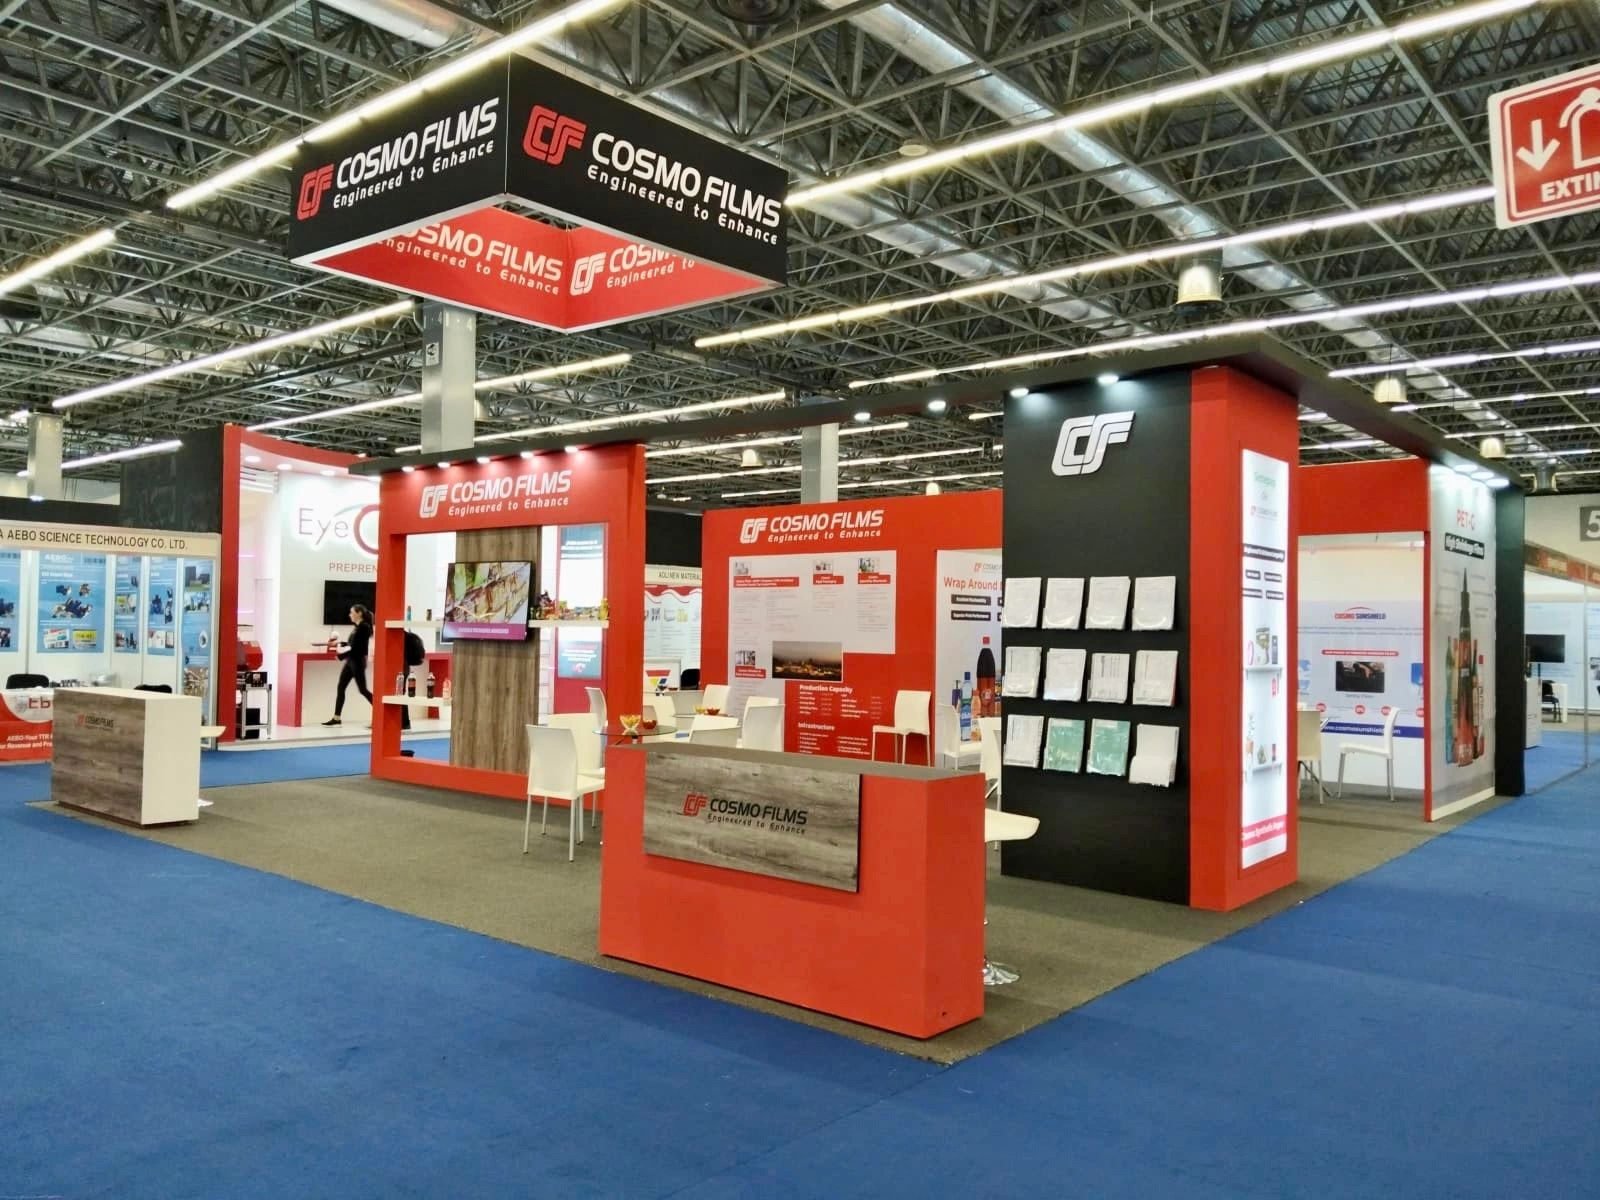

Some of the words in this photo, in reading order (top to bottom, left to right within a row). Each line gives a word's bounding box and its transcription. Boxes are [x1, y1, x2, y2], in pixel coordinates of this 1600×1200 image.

[337, 132, 418, 189] COSMO
[420, 97, 499, 159] FILMS
[333, 171, 403, 209] Engineered
[410, 166, 424, 183] to
[432, 140, 494, 173] Enhance
[592, 132, 702, 197] COSMO
[704, 175, 782, 228] FILMS
[587, 165, 684, 212] Engineered
[694, 203, 709, 221] to
[718, 213, 778, 245] Enhance
[378, 238, 467, 269] ngineered
[476, 261, 491, 275] to
[500, 270, 559, 295] Enhance
[486, 239, 563, 282] FILMS
[607, 261, 674, 288] Engineered
[451, 476, 513, 503] COSMO
[514, 470, 572, 497] FILMS
[448, 501, 502, 517] Engineered
[507, 502, 518, 511] to
[524, 497, 569, 509] Enhance
[770, 513, 829, 533] COSMO
[830, 509, 884, 529] FILMS
[7, 529, 36, 541] AEBO
[40, 531, 82, 543] SCIENCE
[85, 534, 149, 547] TECHNOLOGY
[151, 538, 167, 549] CO.
[170, 539, 188, 549] LTD.
[768, 532, 819, 543] Engineered
[824, 532, 834, 540] to
[839, 530, 881, 539] Enhance
[944, 577, 966, 591] Wrap
[968, 579, 998, 590] Around
[829, 685, 853, 694] Capacity
[798, 722, 835, 731] Infrastructure
[708, 813, 751, 826] Engineered
[770, 822, 805, 834] Enhance
[710, 799, 760, 817] COSMO
[762, 806, 808, 825] FILMS
